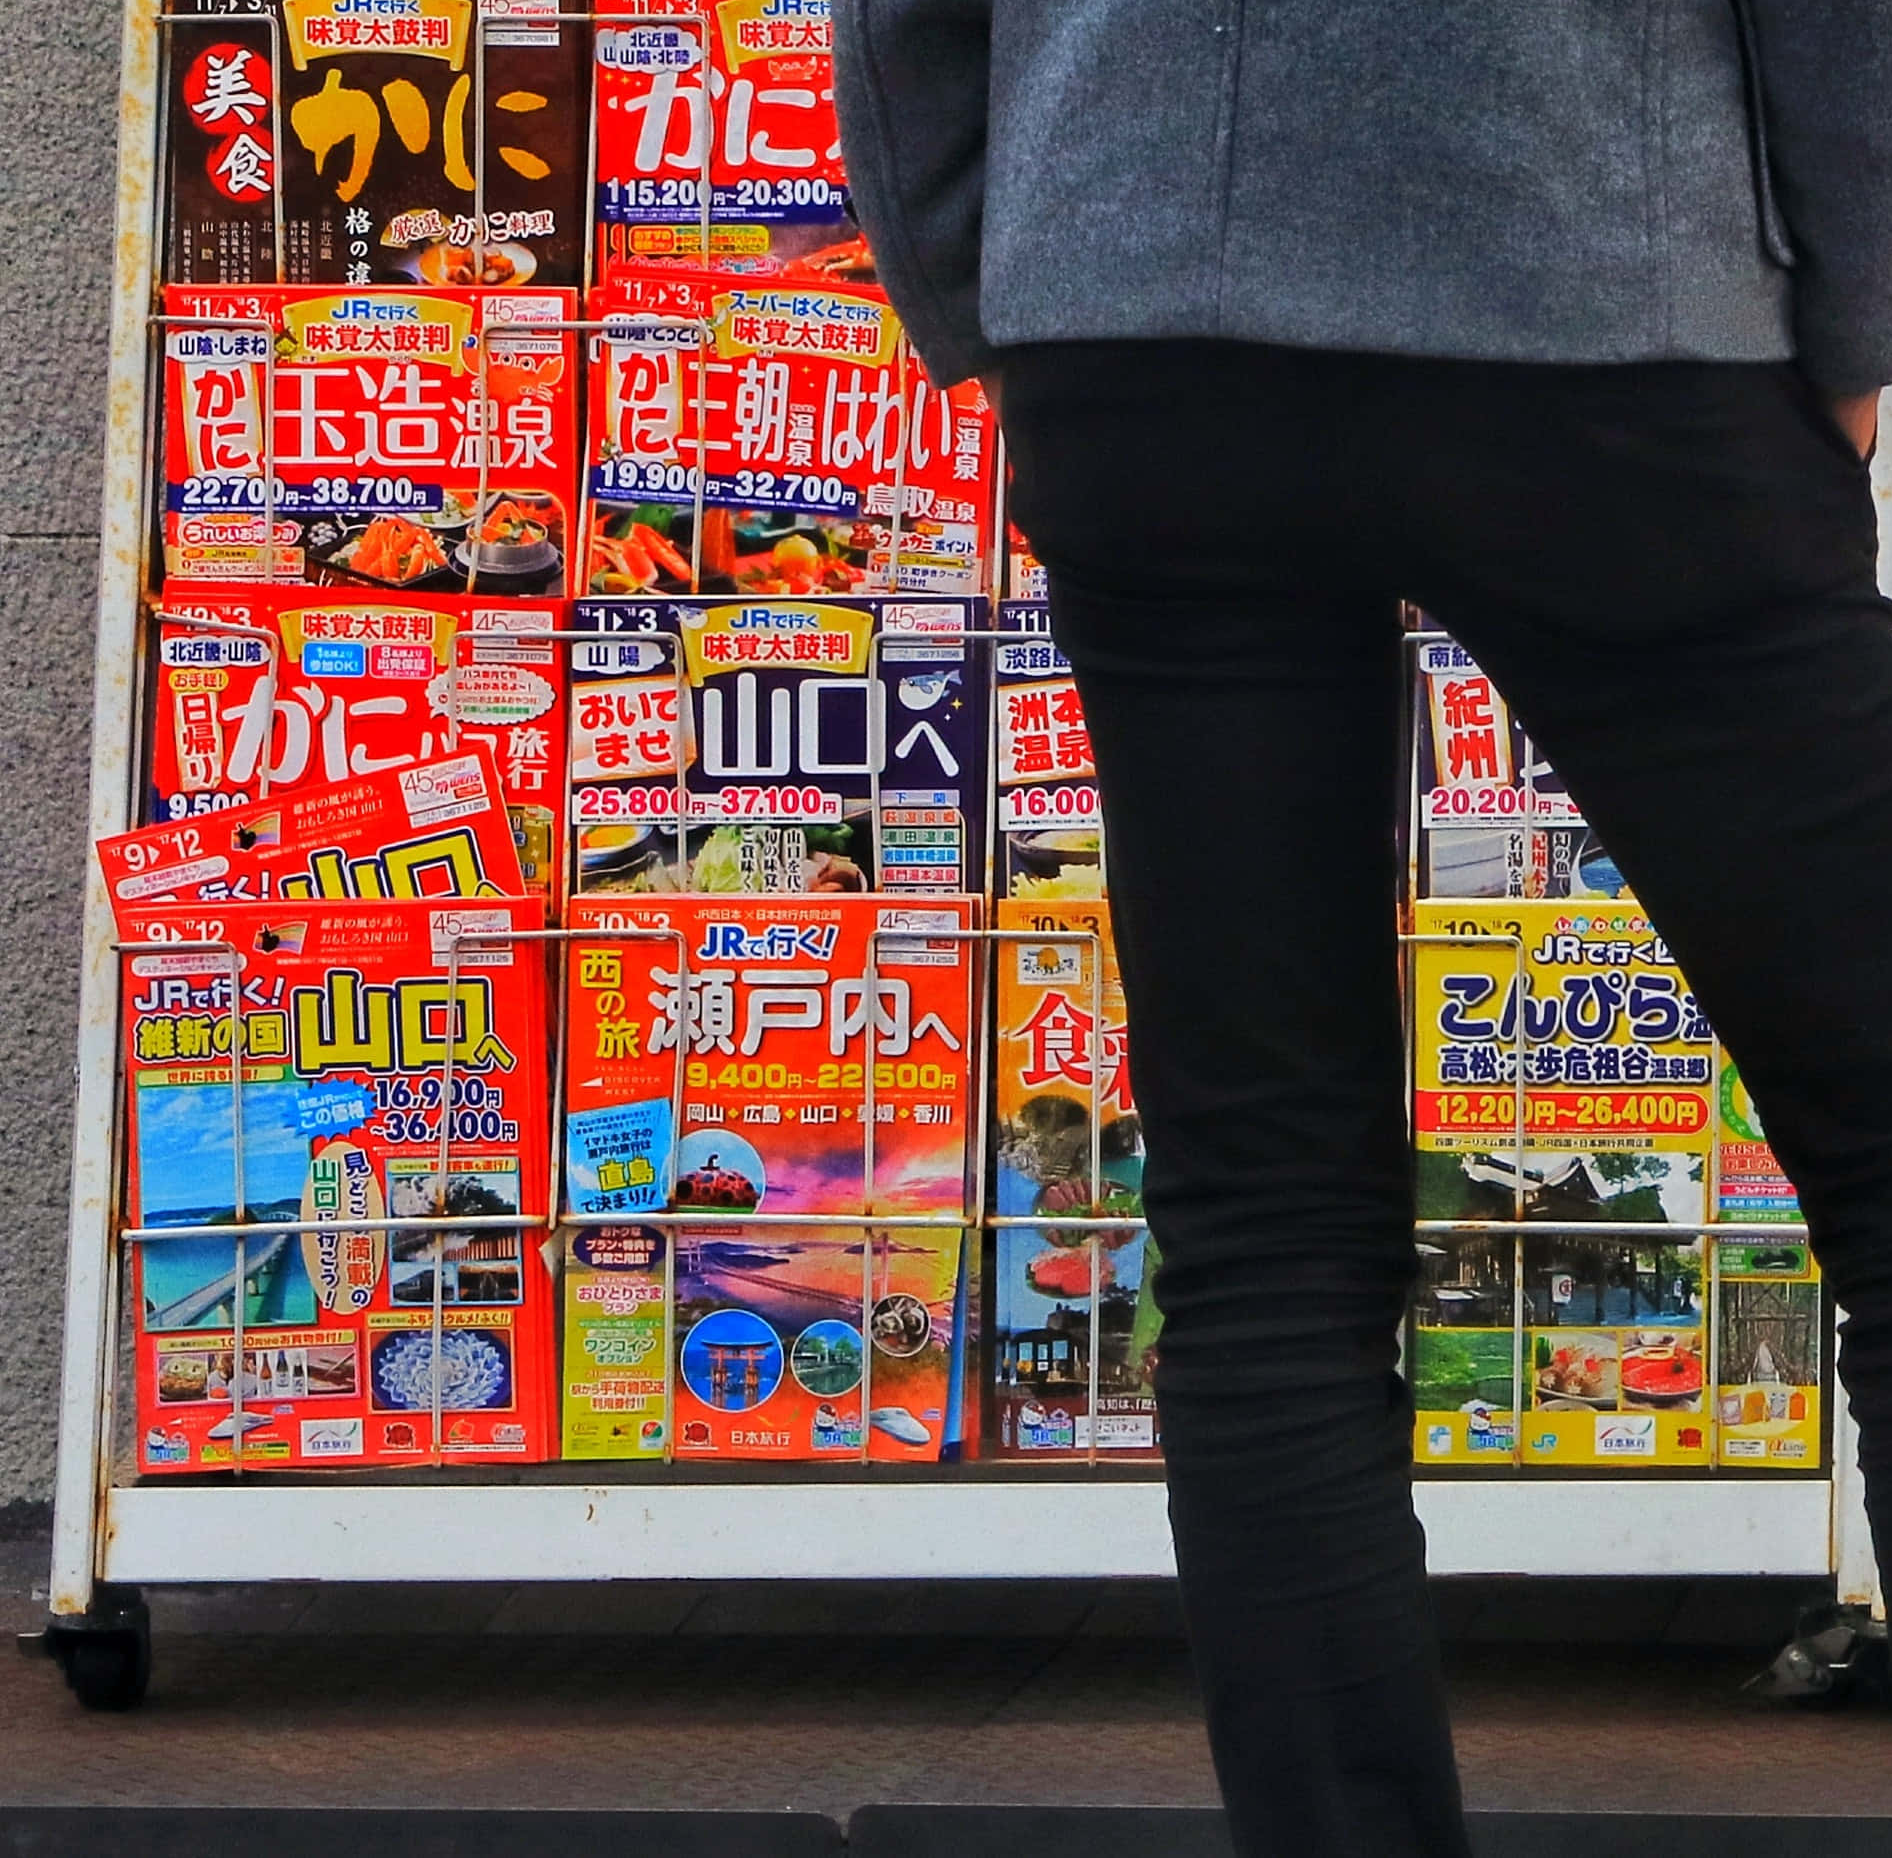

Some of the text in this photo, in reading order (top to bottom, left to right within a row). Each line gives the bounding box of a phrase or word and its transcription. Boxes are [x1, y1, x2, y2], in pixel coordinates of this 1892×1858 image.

[306, 17, 449, 48] 味覚太鼓判
[331, 299, 418, 321] JRで行く
[730, 290, 883, 321] スーパーはくとで行く
[305, 324, 451, 355] 味覚太鼓判
[301, 613, 428, 641] 味覚太鼓判
[704, 633, 849, 662] 味覚太鼓判
[700, 673, 959, 778] 山口へ
[1442, 678, 1496, 780] 紀州
[293, 970, 515, 1073] 山口へ
[647, 968, 959, 1056] 瀬戸内へ
[599, 1158, 654, 1189] 直島
[730, 1430, 791, 1447] 日本旅行
